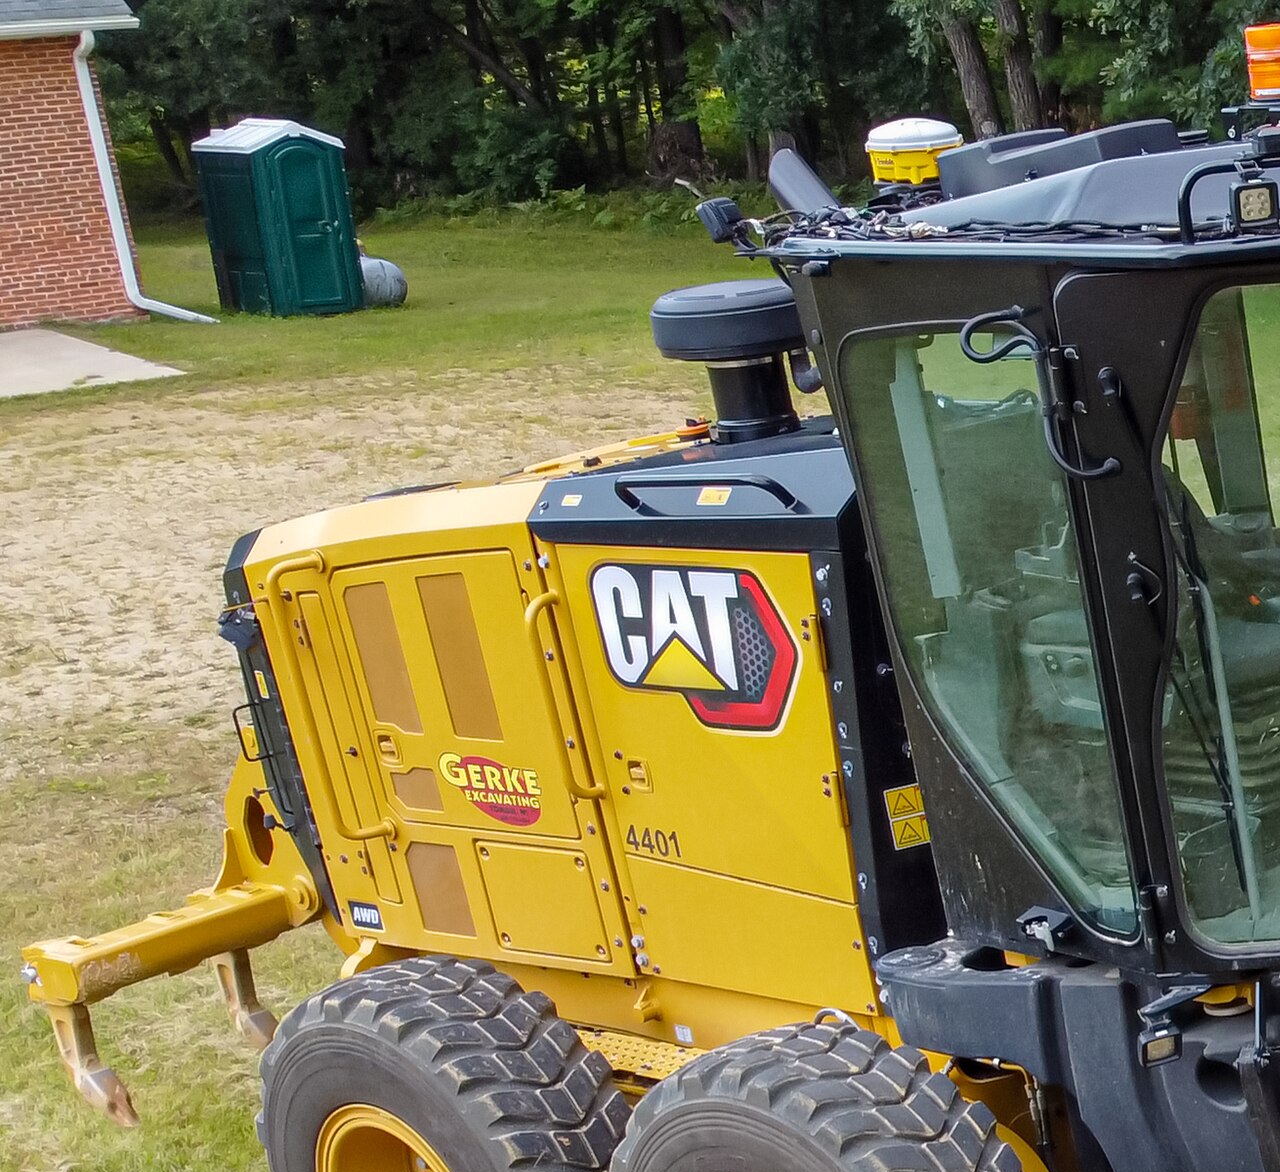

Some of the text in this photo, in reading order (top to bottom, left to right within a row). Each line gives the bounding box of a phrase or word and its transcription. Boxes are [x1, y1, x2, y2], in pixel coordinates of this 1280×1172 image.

[592, 565, 739, 692] CAT
[439, 753, 541, 795] GERKE
[464, 789, 540, 809] EXCAVATING
[626, 824, 682, 858] 4401
[353, 906, 380, 925] AWD
